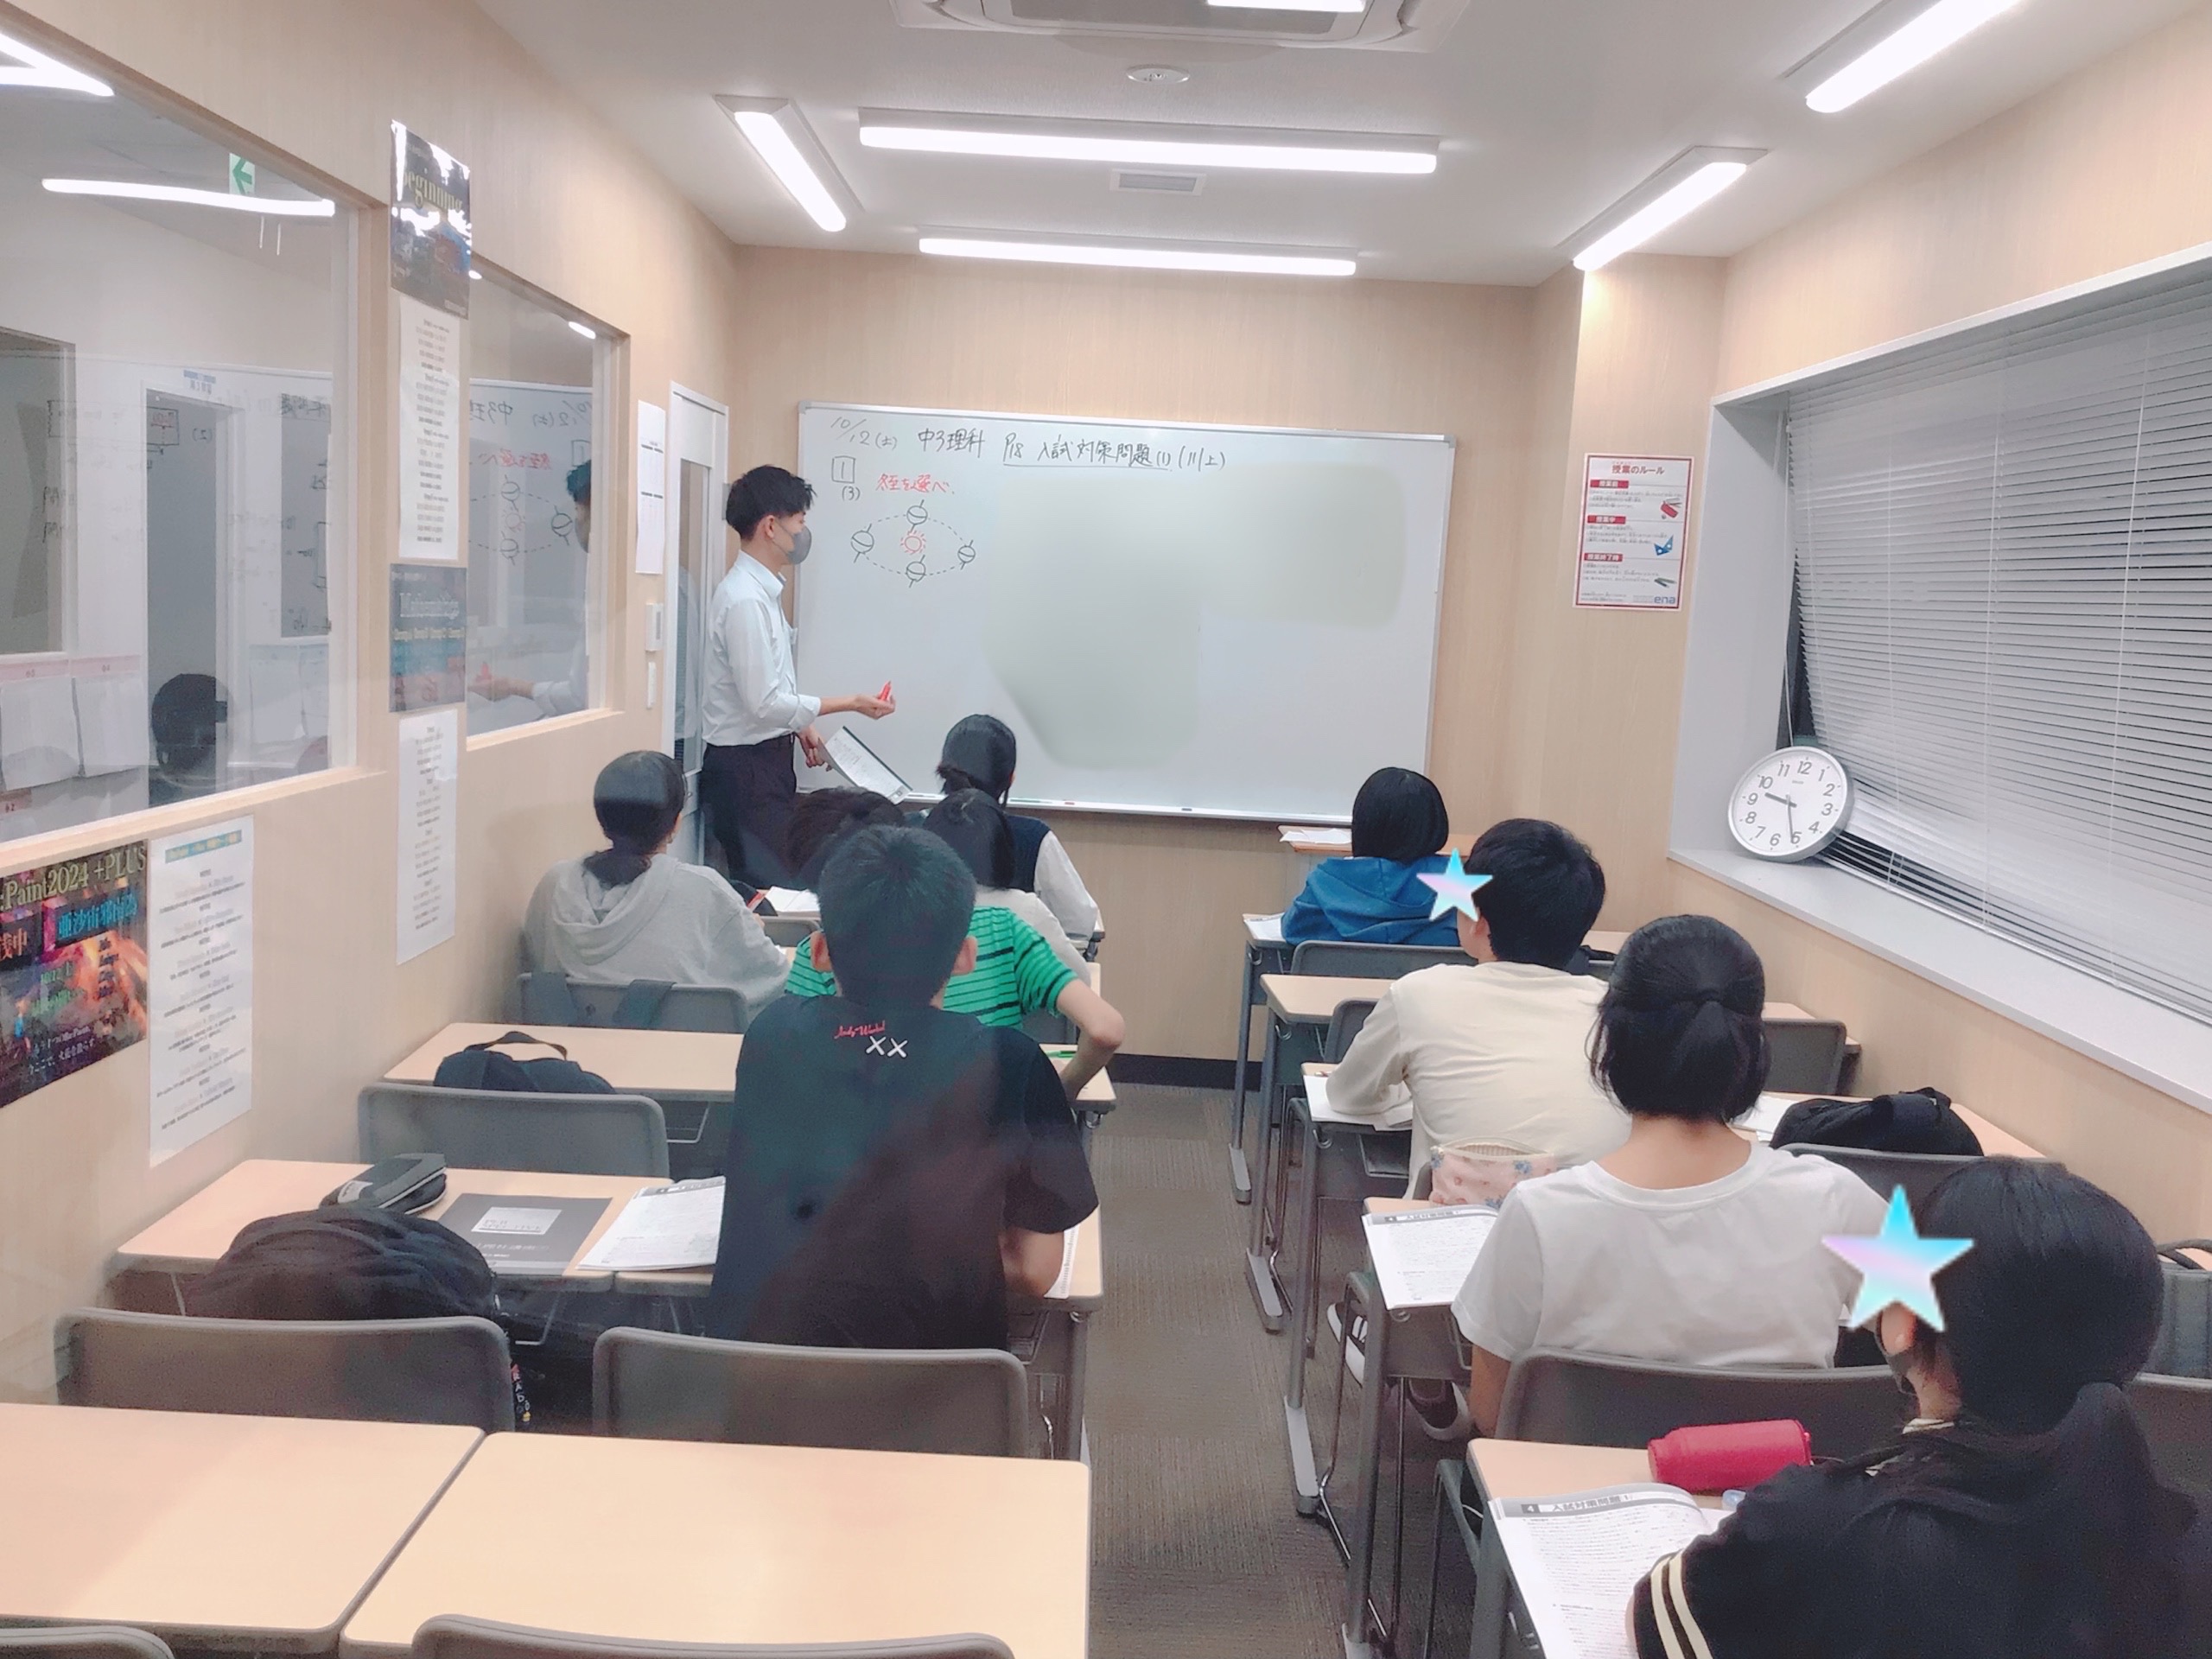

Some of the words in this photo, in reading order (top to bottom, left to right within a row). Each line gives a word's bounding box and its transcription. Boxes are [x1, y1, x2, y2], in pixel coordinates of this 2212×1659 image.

[918, 428, 986, 458] 中3理科
[1611, 465, 1665, 474] 授業のルール
[842, 486, 861, 501] (3)
[1654, 595, 1676, 605] ena
[1778, 764, 1789, 777] 11
[1797, 761, 1812, 775] 12
[1818, 769, 1825, 782] 1
[1758, 776, 1773, 789] 10
[1823, 784, 1835, 797] 2
[1747, 792, 1758, 805] 9
[1821, 803, 1833, 816] 3
[1745, 811, 1757, 824] 8
[1755, 826, 1766, 838] 7
[1808, 821, 1820, 834] 4
[1770, 833, 1781, 846] 6
[1790, 831, 1802, 844] 5
[94, 845, 146, 880] +PLUS
